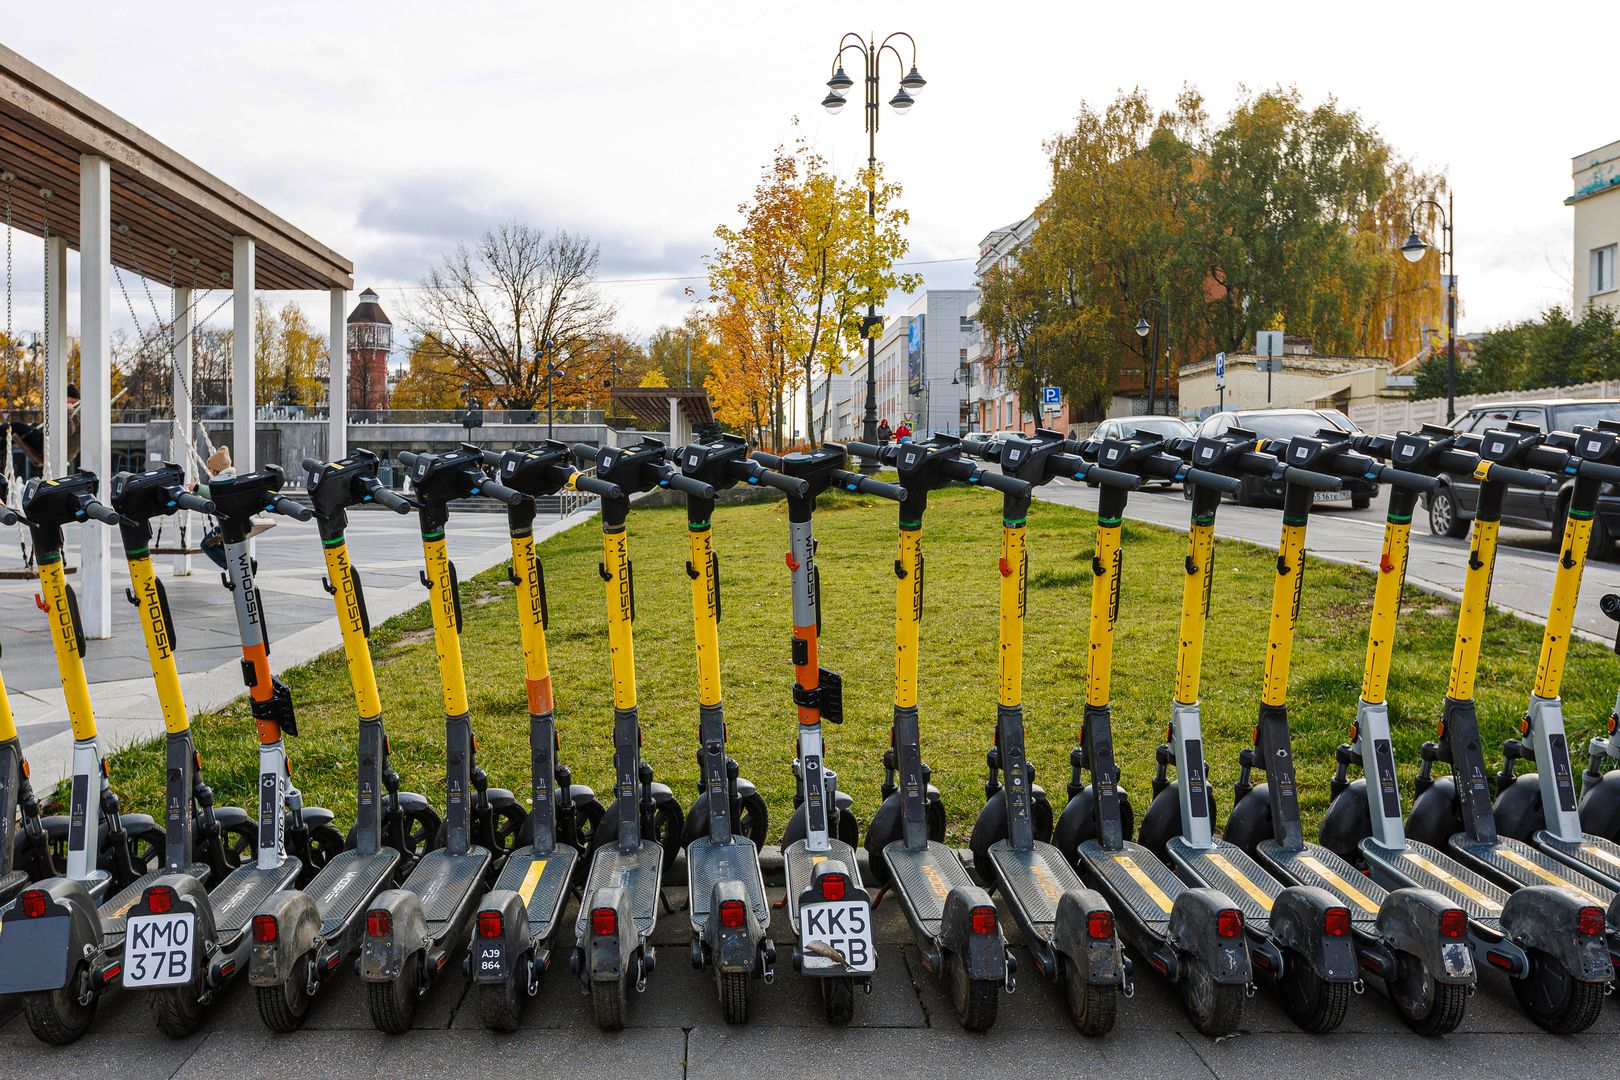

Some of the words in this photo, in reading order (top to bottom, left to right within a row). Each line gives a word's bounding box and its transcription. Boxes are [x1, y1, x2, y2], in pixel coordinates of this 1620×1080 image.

[1046, 389, 1056, 402] P
[50, 568, 77, 652] WHOOSH
[238, 552, 259, 625] WHOOSH
[336, 550, 362, 633] WHOOSH
[435, 544, 456, 629] WHOOSH
[524, 541, 542, 625] WHOOSH
[617, 537, 630, 622] WHOOSH
[703, 535, 716, 619] WHOOSH
[804, 534, 815, 607] WHOOSH
[912, 538, 921, 622] WHOOSH
[1017, 533, 1027, 618] WHOOSH
[1107, 547, 1120, 632] WHOOSH
[143, 576, 171, 659] WHOOSH
[481, 949, 501, 959] AJ9
[802, 938, 868, 966] 5B
[807, 906, 866, 935] KK5
[130, 949, 188, 981] 37B
[481, 960, 501, 970] 864
